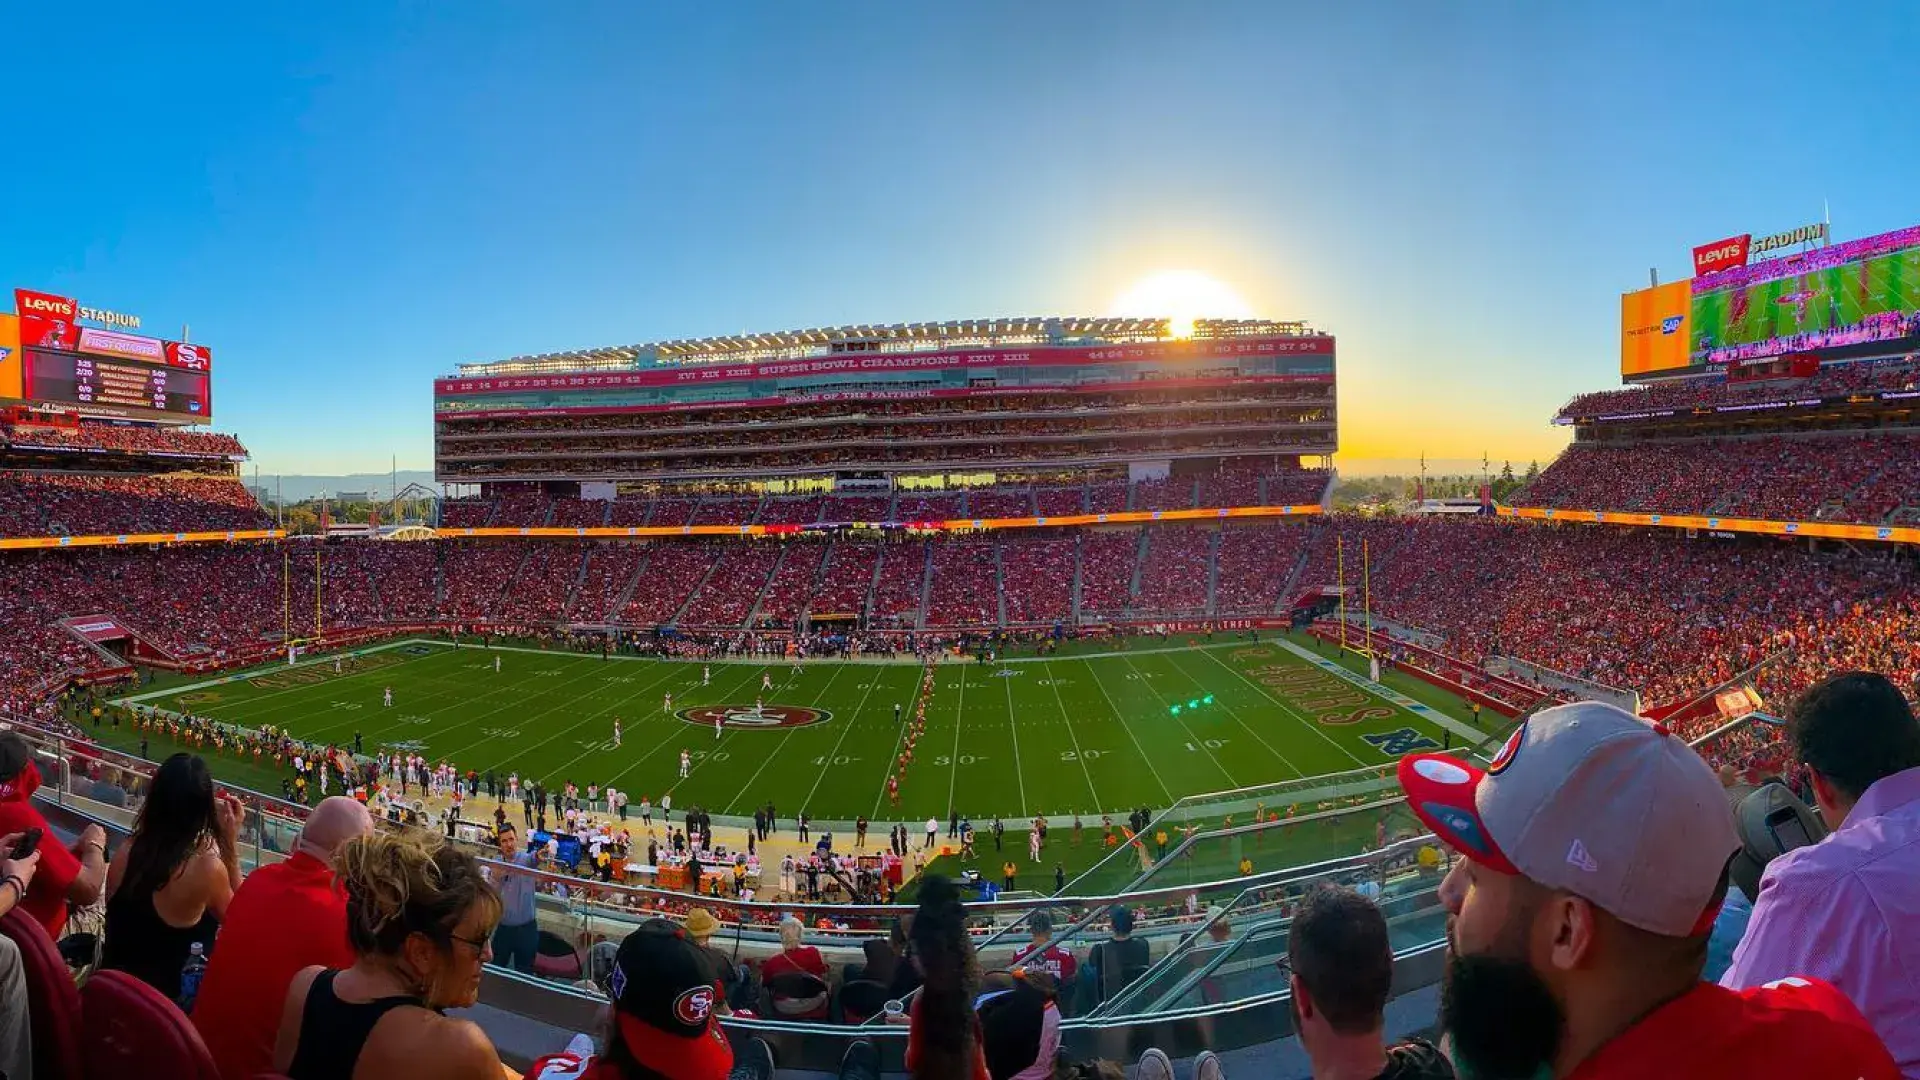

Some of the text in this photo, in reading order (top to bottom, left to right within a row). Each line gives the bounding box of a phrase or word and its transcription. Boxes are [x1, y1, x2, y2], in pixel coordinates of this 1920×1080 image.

[1749, 223, 1825, 254] STADIUM
[80, 307, 141, 328] STADIUM
[1663, 319, 1680, 334] SAP
[87, 338, 112, 348] FIRST
[758, 364, 809, 375] SUPER
[811, 360, 859, 371] BOWL
[860, 355, 960, 368] CHAMPIONS
[842, 391, 868, 399] THE
